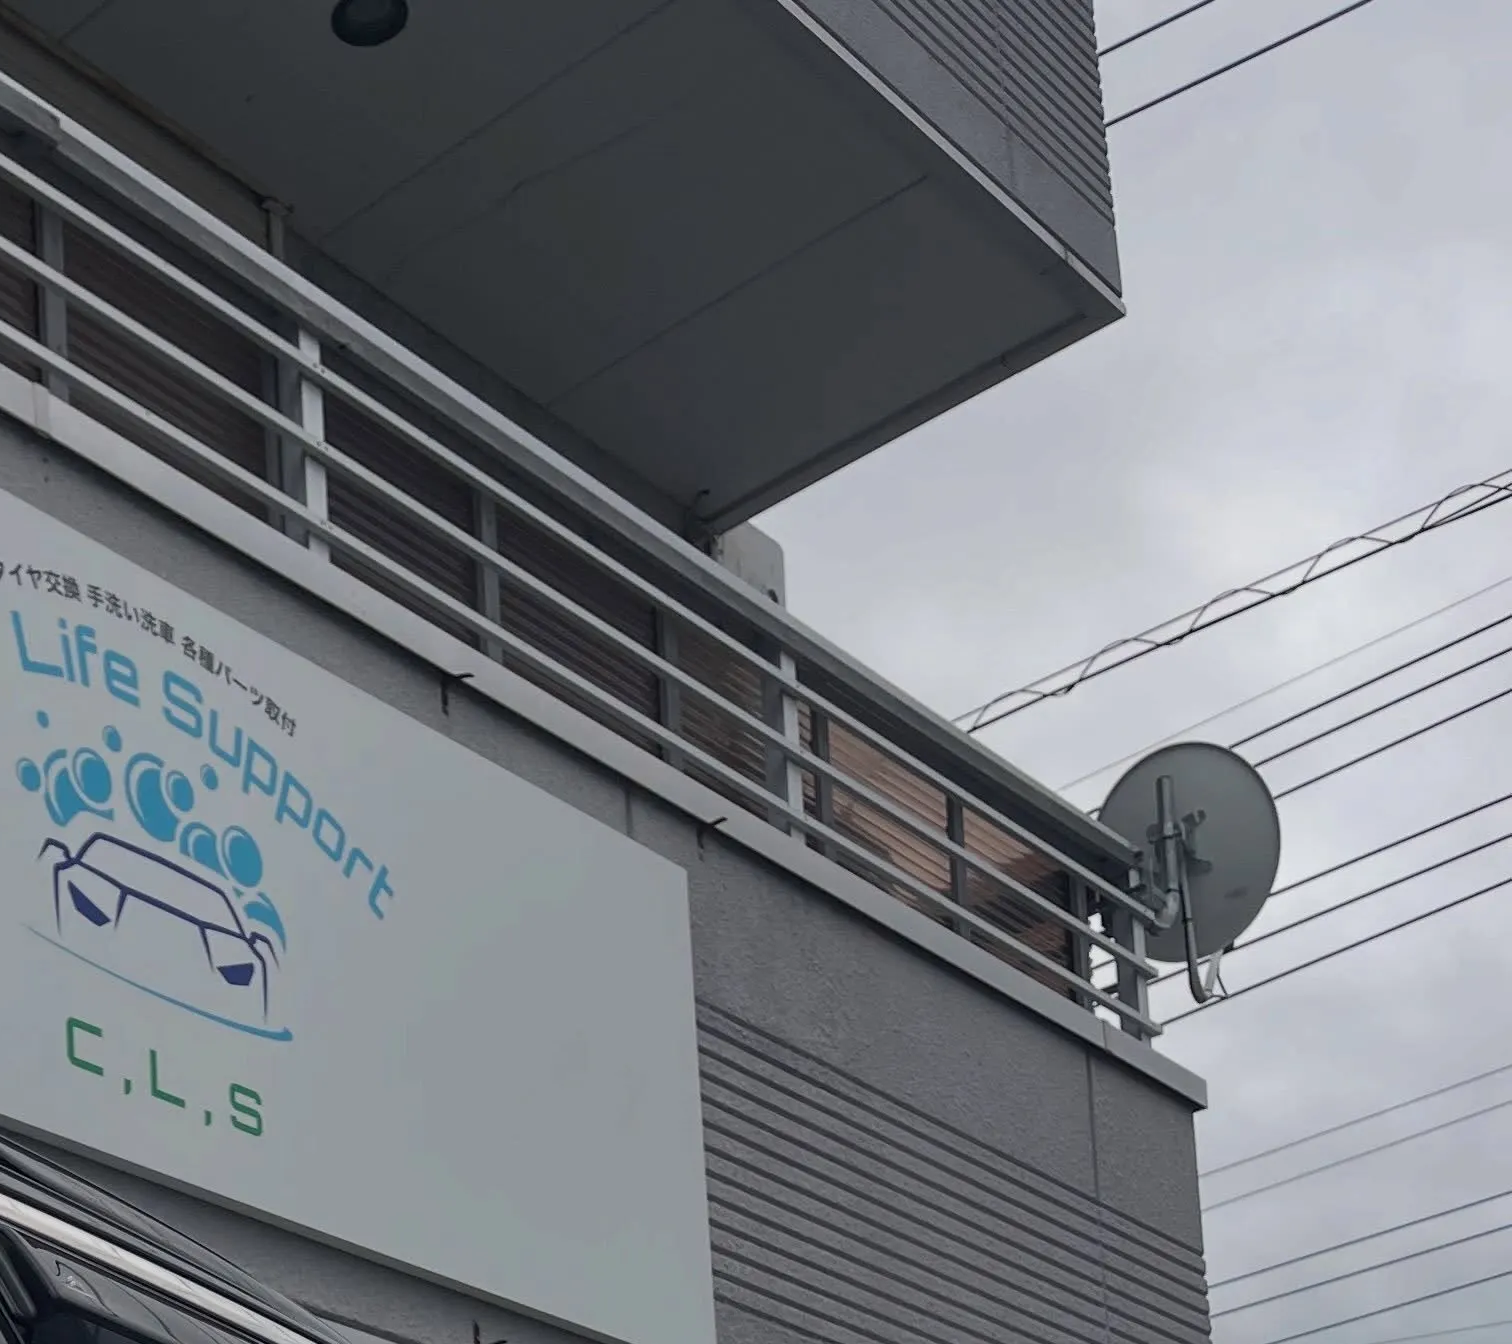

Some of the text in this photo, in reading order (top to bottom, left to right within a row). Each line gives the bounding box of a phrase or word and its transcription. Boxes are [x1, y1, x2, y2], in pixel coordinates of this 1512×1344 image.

[10, 611, 140, 708] Life
[162, 670, 394, 921] Support
[87, 584, 175, 645] 手洗い洗車
[181, 635, 297, 738] 各種パーツ取付
